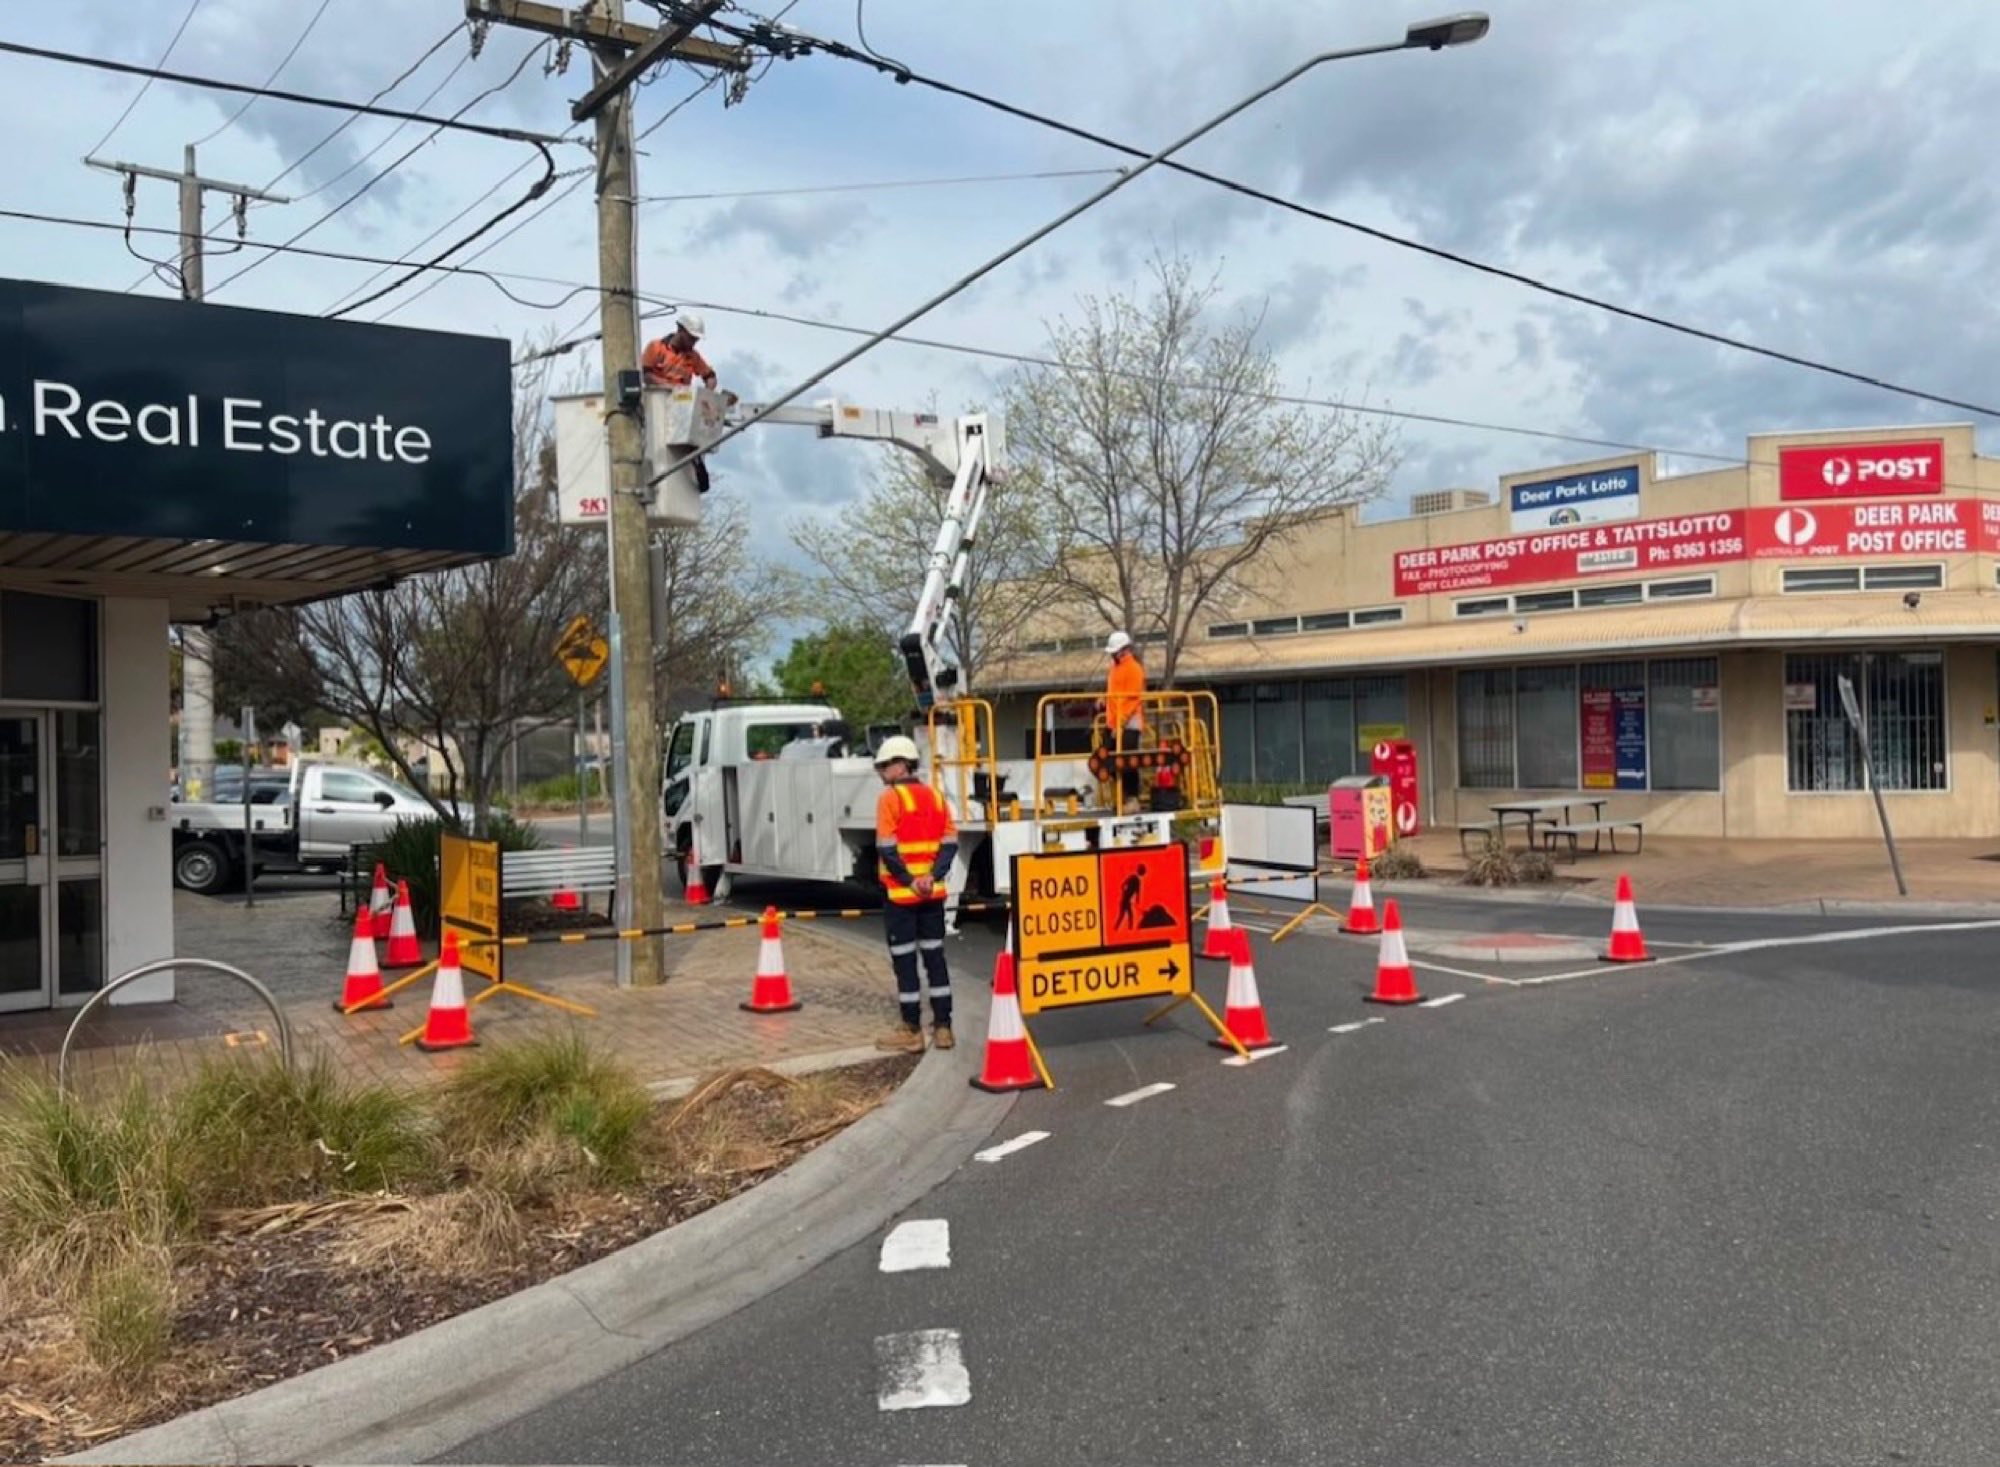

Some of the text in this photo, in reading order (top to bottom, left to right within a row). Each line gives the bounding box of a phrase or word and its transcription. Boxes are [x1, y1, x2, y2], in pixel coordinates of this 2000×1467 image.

[34, 379, 199, 447] Real
[223, 397, 432, 464] Estate
[1856, 457, 1932, 481] POST
[1520, 477, 1627, 503] Deer Park Lotto
[1855, 503, 1958, 526] DEER PARK
[1399, 513, 1732, 568] DEER PARK POST OFFICE & TATTSLOTTO
[1650, 547, 1671, 562] Ph:
[1672, 541, 1706, 560] 9363
[1709, 537, 1743, 555] 1356
[1847, 529, 1966, 551] POST OFFICE
[1402, 572, 1421, 581] FAX
[1429, 560, 1509, 579] PHOTOCOPYING
[1441, 573, 1492, 589] CLEANING
[1030, 875, 1089, 899] ROAD
[1023, 909, 1097, 936] CLOSED
[1033, 962, 1140, 998] DETOUR
